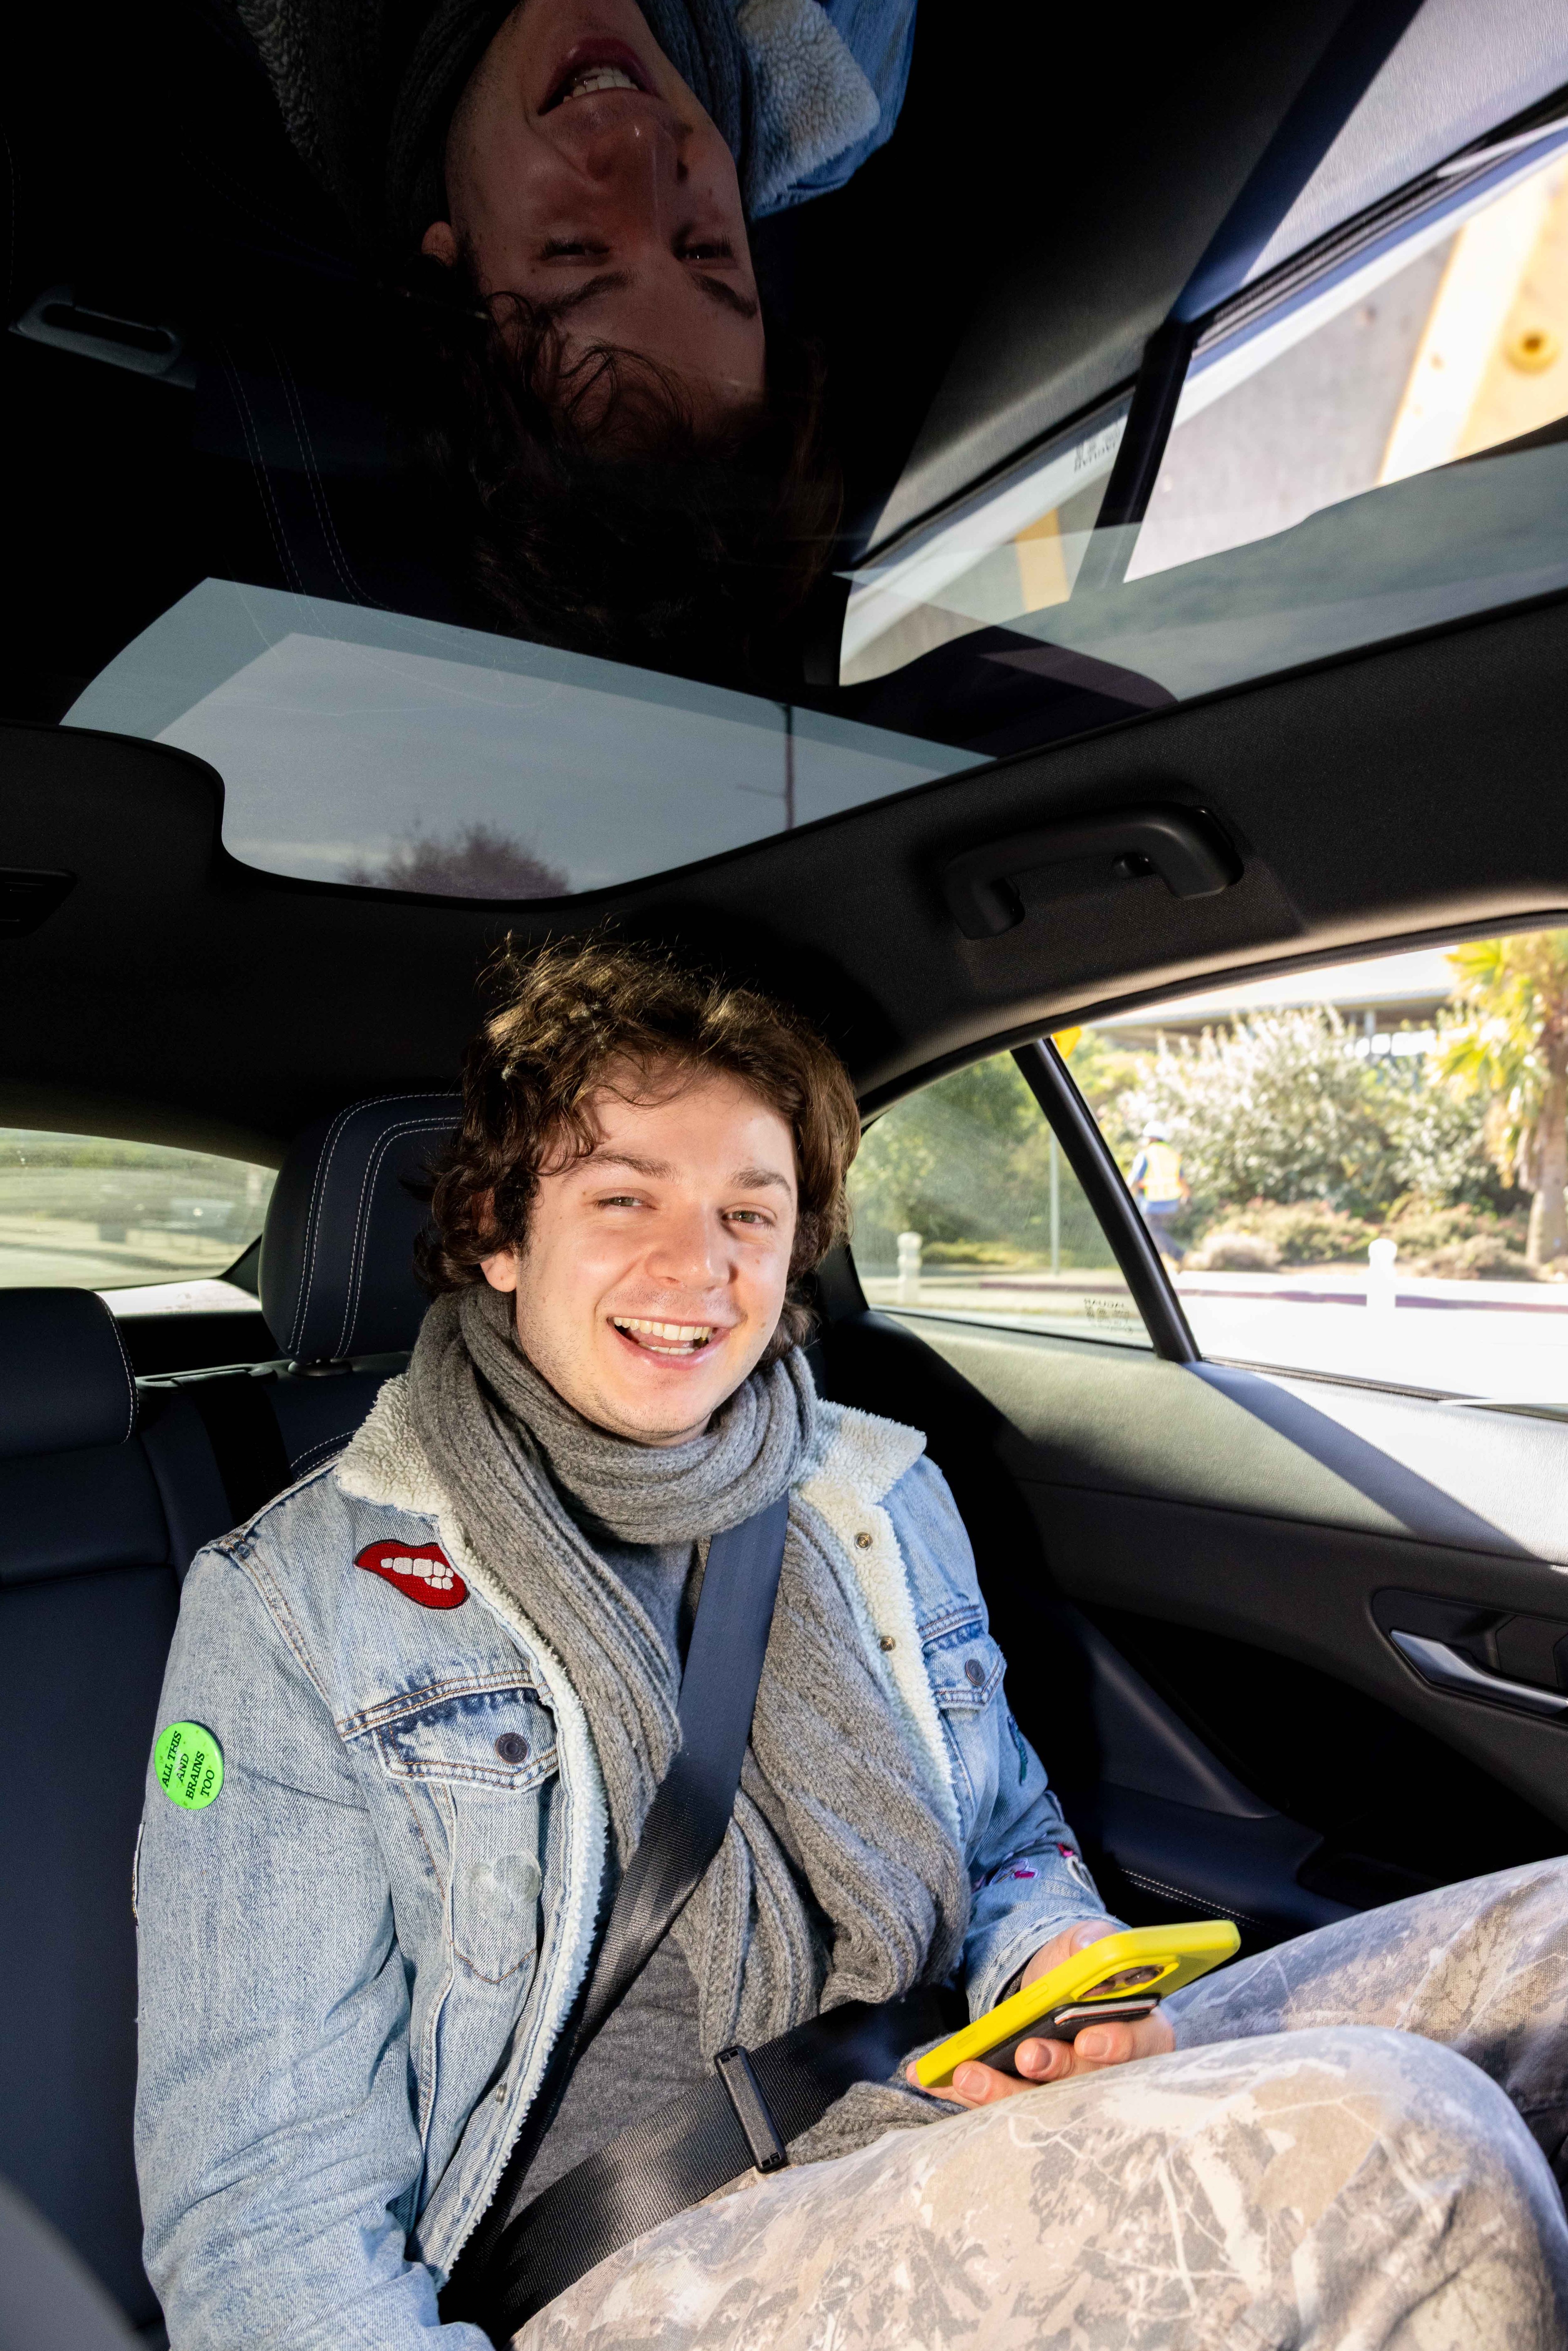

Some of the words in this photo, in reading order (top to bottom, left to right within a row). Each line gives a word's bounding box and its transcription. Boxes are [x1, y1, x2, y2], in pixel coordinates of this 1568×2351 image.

[167, 1731, 182, 1761] THIS
[162, 1764, 173, 1787] ALL
[176, 1753, 189, 1783] AND
[186, 1751, 205, 1800] BRAINS
[200, 1769, 214, 1796] TOO
